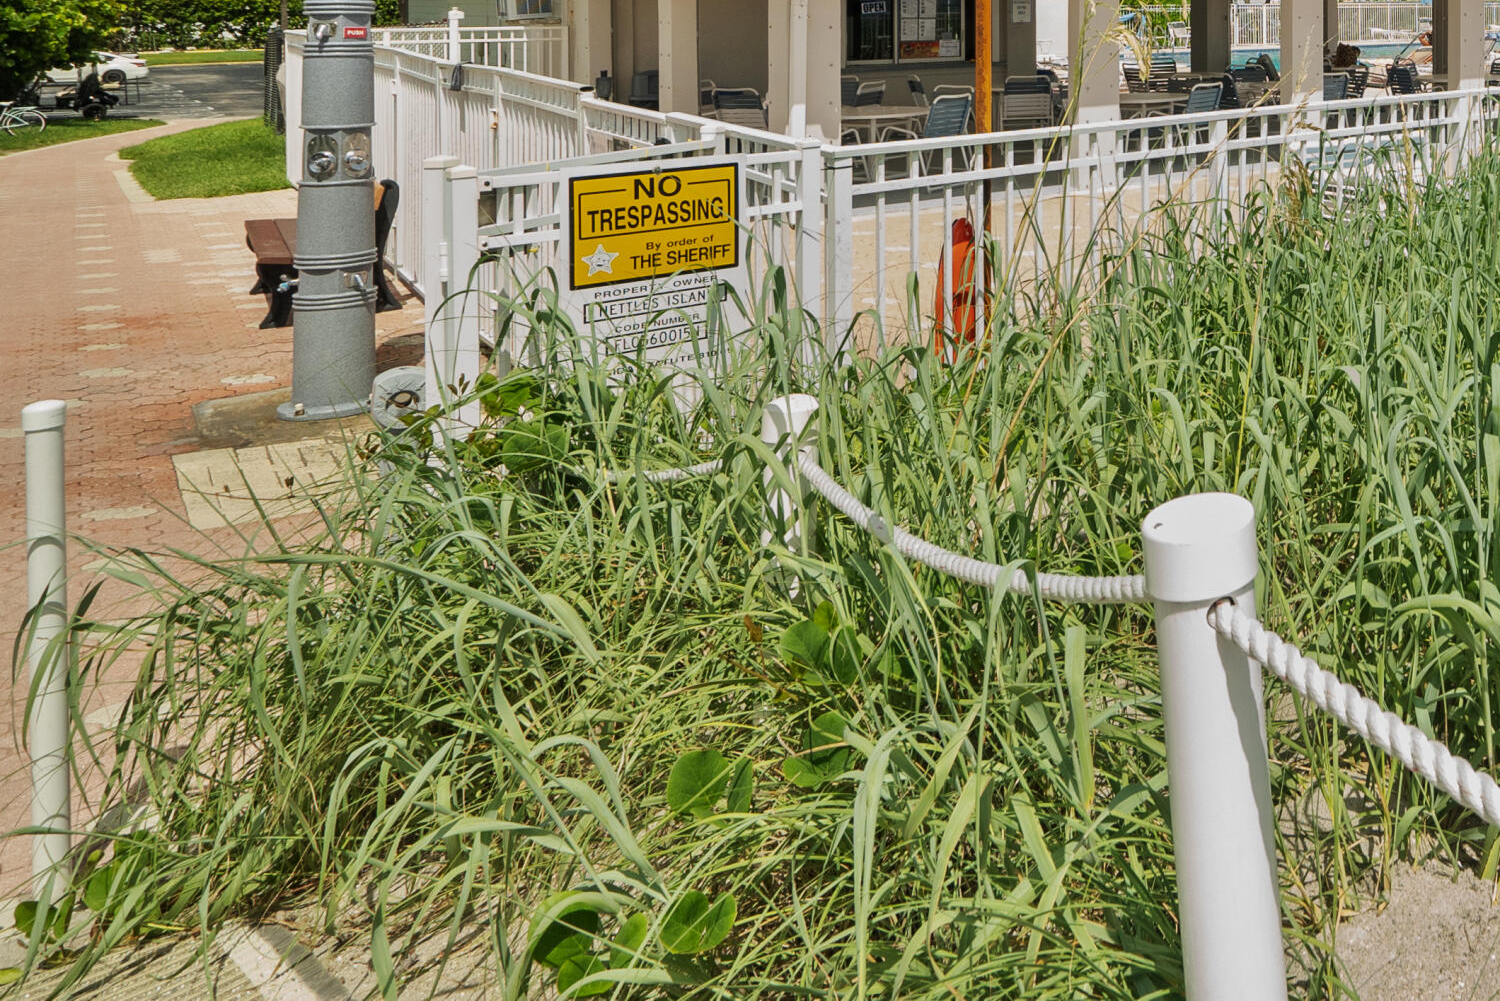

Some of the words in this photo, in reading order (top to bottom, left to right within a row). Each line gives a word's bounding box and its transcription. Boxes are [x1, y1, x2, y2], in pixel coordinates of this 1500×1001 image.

[863, 3, 884, 12] OPEN
[634, 175, 682, 200] NO
[587, 197, 724, 233] TRESPASSING
[646, 242, 661, 252] By
[667, 237, 697, 248] order
[702, 234, 714, 244] of
[630, 252, 662, 270] THE
[666, 244, 731, 266] SHERIFF
[673, 274, 718, 288] OWNER
[600, 298, 660, 318] NETTLES
[667, 289, 715, 307] ISLAN
[615, 323, 648, 334] CODE
[653, 312, 700, 327] NUMBR
